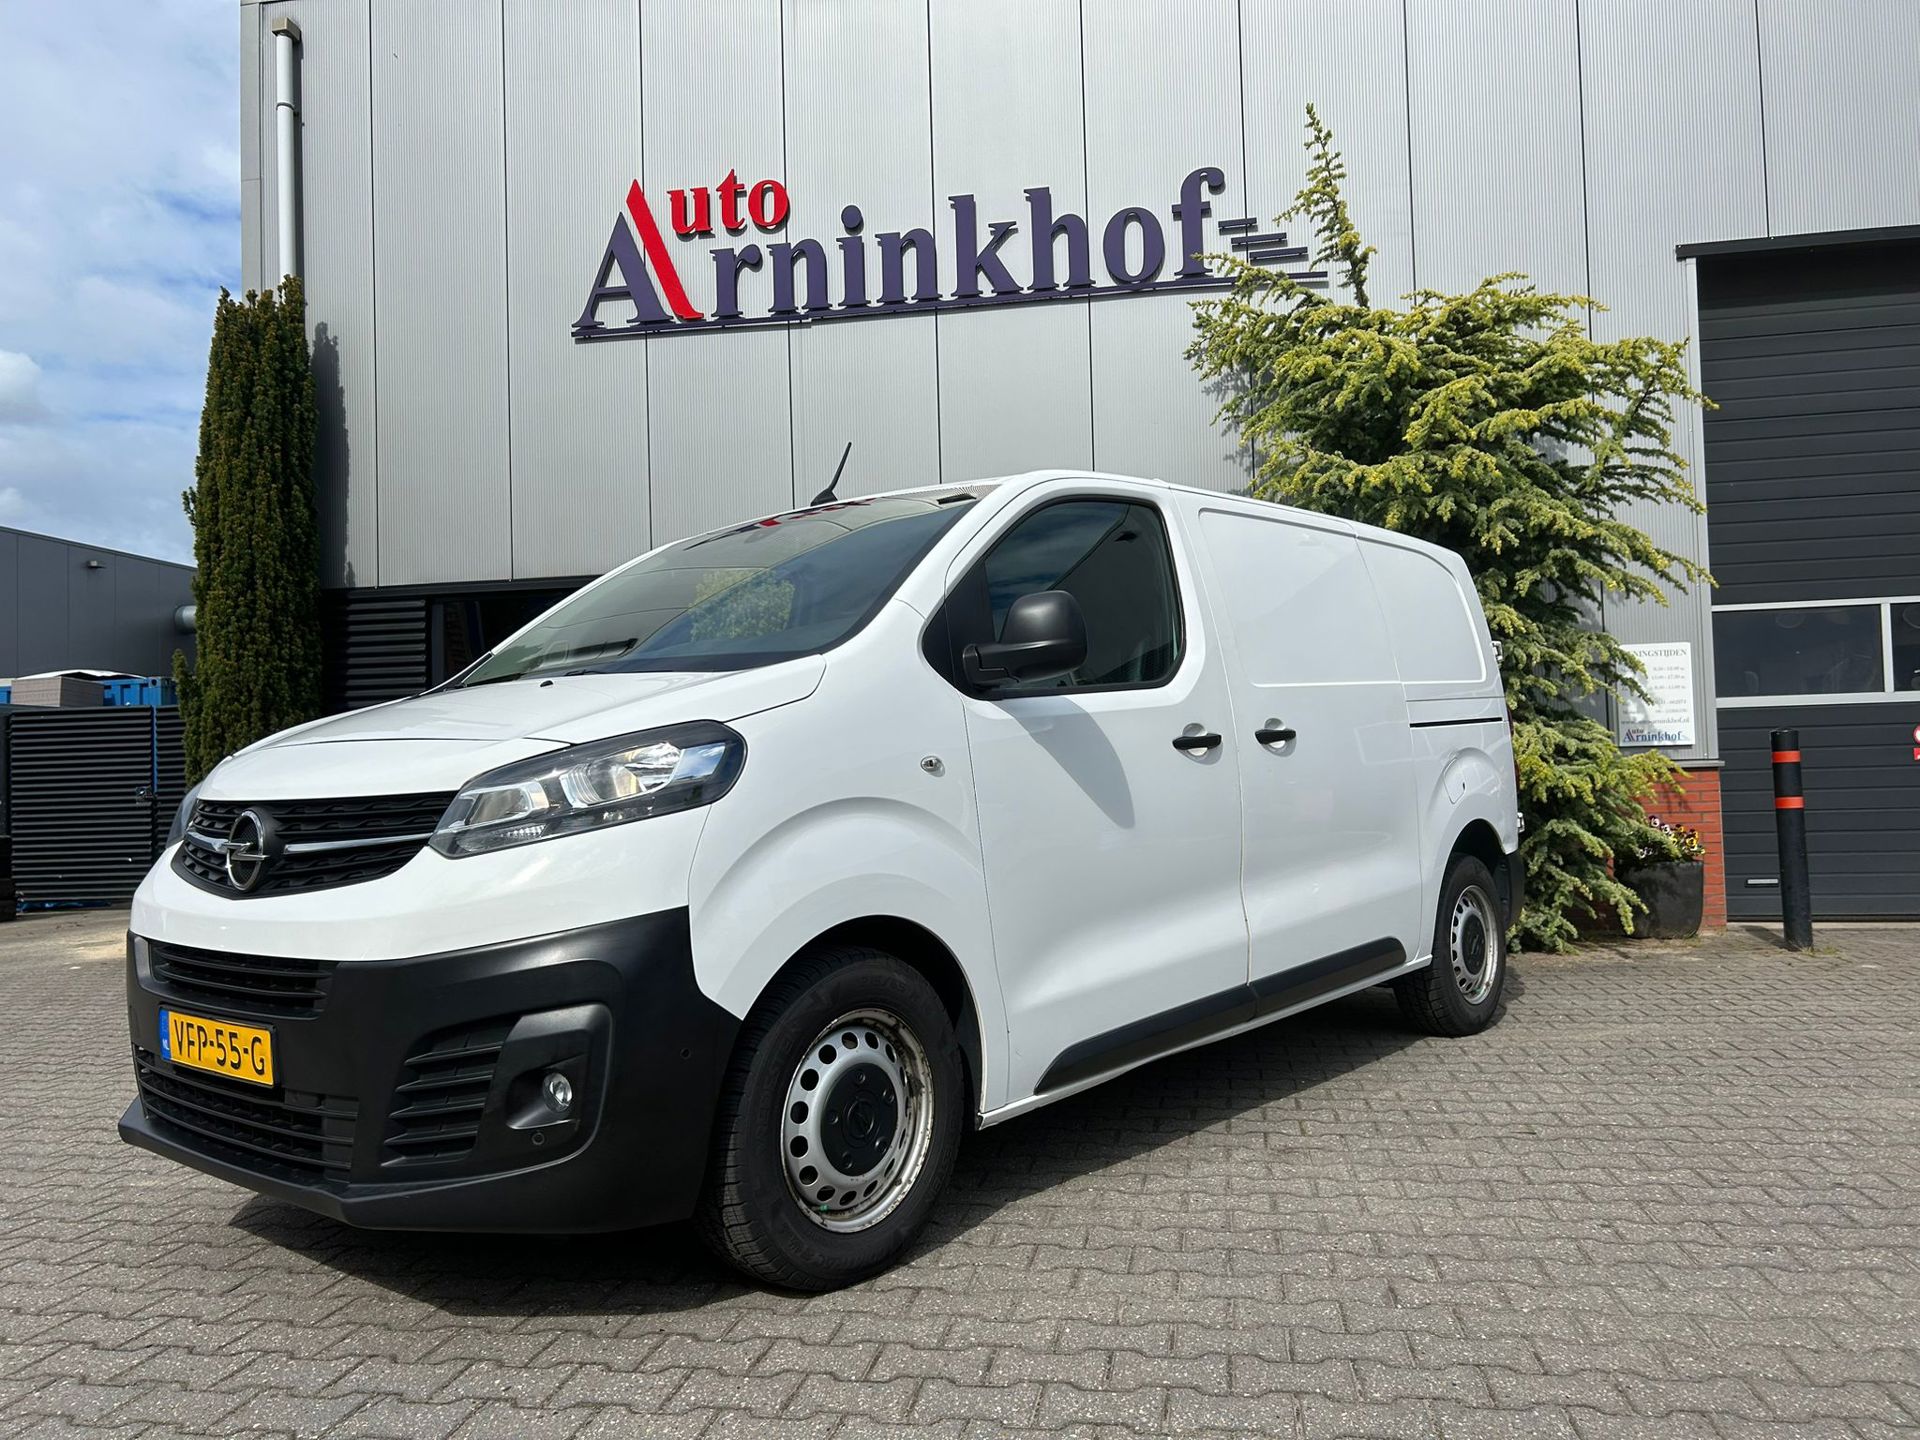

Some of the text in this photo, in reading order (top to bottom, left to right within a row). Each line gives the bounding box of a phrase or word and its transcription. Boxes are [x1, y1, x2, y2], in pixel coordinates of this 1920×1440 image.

[571, 166, 1225, 328] Arninkhof
[1623, 730, 1682, 742] Arninkhof
[174, 1019, 265, 1076] VFP-55-G
